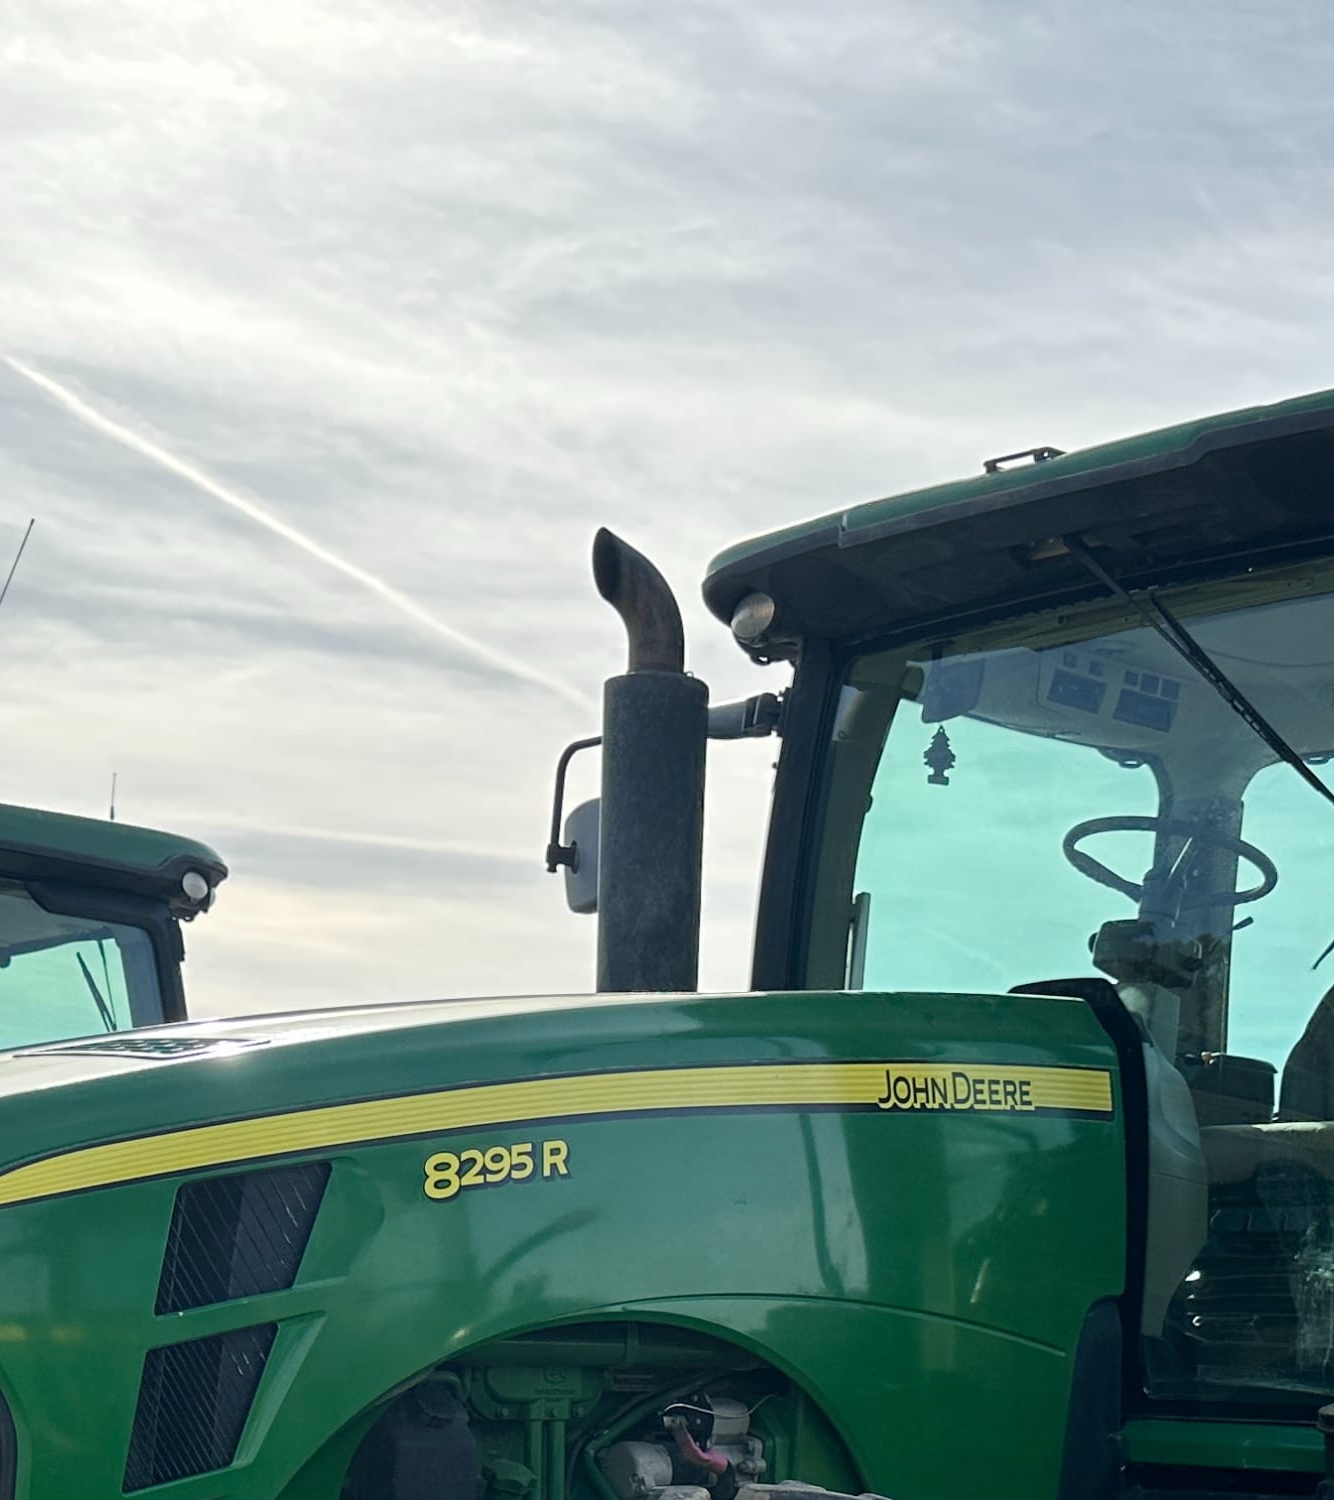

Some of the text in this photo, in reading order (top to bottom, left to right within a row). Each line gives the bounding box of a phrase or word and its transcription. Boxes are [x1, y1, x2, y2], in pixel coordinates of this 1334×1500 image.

[878, 1069, 1034, 1109] JOHN DEERE
[424, 1139, 569, 1200] 8295 R
